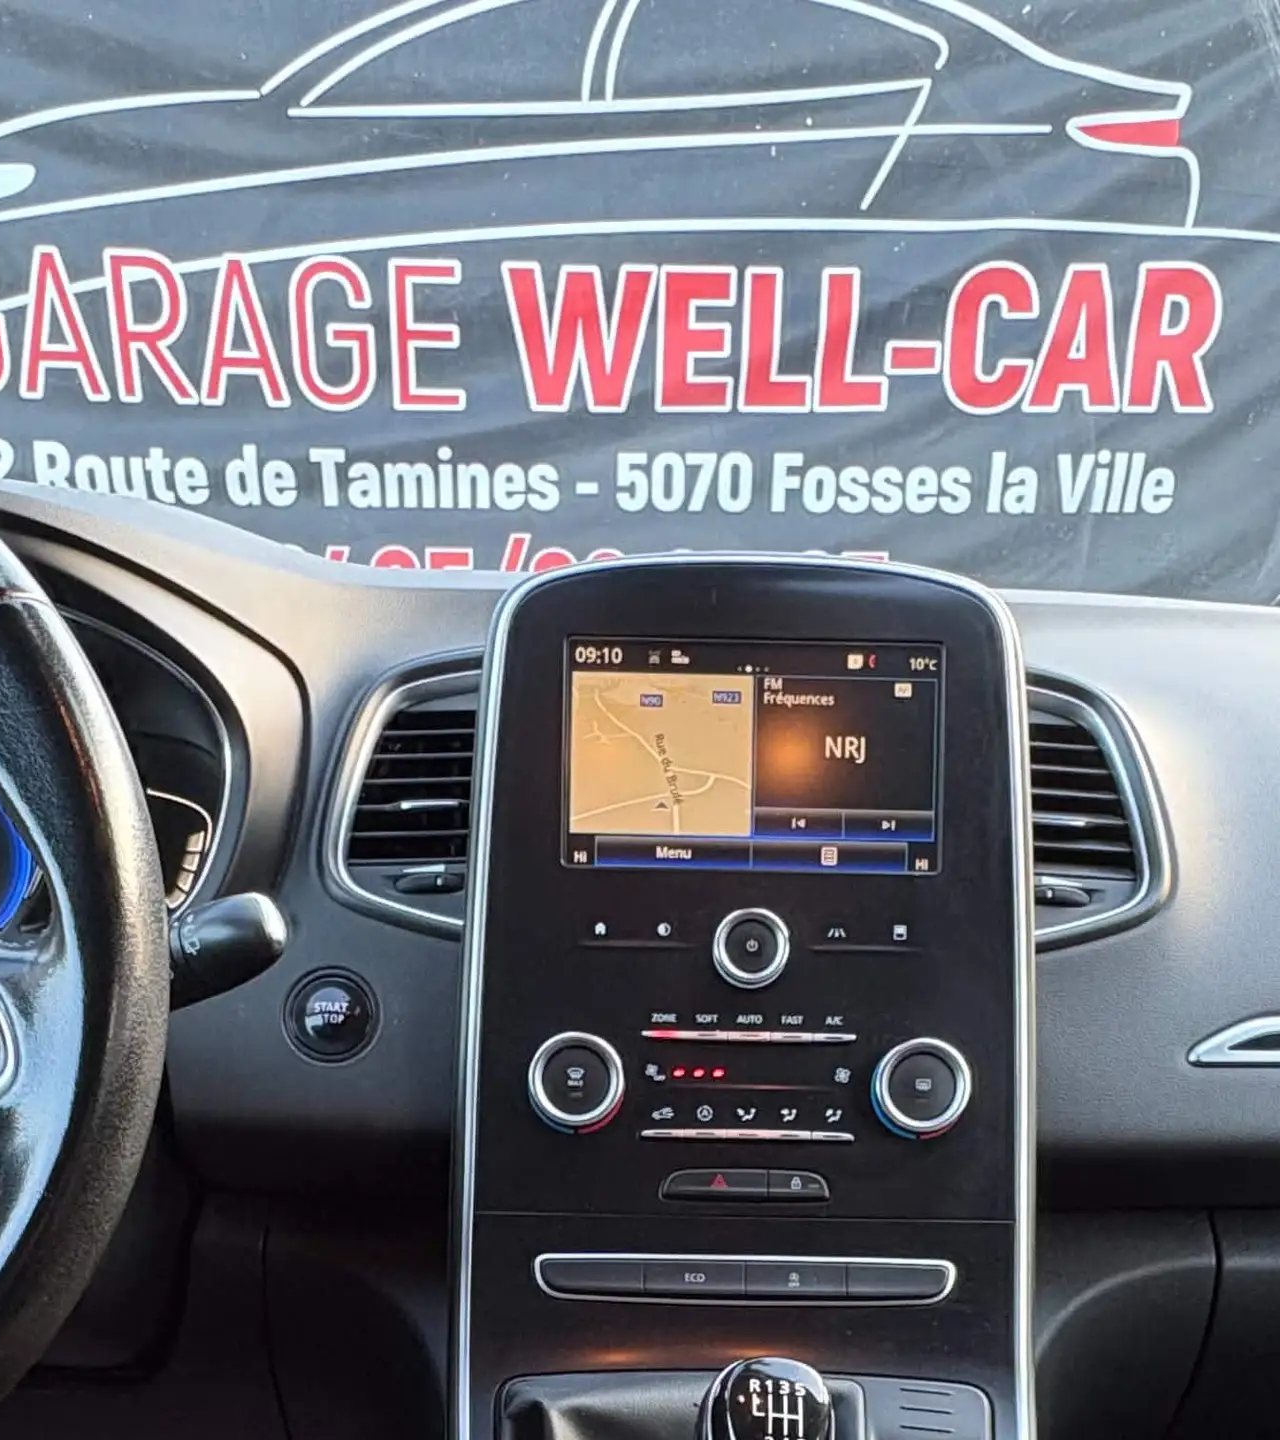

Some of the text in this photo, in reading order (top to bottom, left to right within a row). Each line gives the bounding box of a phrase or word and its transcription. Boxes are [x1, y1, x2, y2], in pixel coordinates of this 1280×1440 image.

[501, 261, 1222, 414] WELL-CAR
[33, 439, 210, 504] Route
[226, 443, 298, 508] de
[309, 446, 560, 512] Tamines
[616, 452, 753, 513] 5070
[771, 452, 971, 514] Fosses
[986, 452, 1038, 514] la
[1057, 449, 1175, 514] Ville
[575, 646, 623, 664] 09:10
[763, 678, 783, 690] FM
[763, 691, 835, 708] Fréquences
[655, 733, 668, 756] Rue
[824, 736, 867, 764] NRJ
[656, 846, 692, 860] Menu
[314, 1001, 349, 1013] START
[651, 1013, 678, 1023] ZONE
[695, 1014, 719, 1024] SOFT
[736, 1015, 764, 1025] AUTO
[780, 1015, 805, 1025] FAST
[824, 1016, 845, 1026] A/C
[684, 1272, 707, 1284] ECO
[749, 1378, 807, 1396] R 1 3 5
